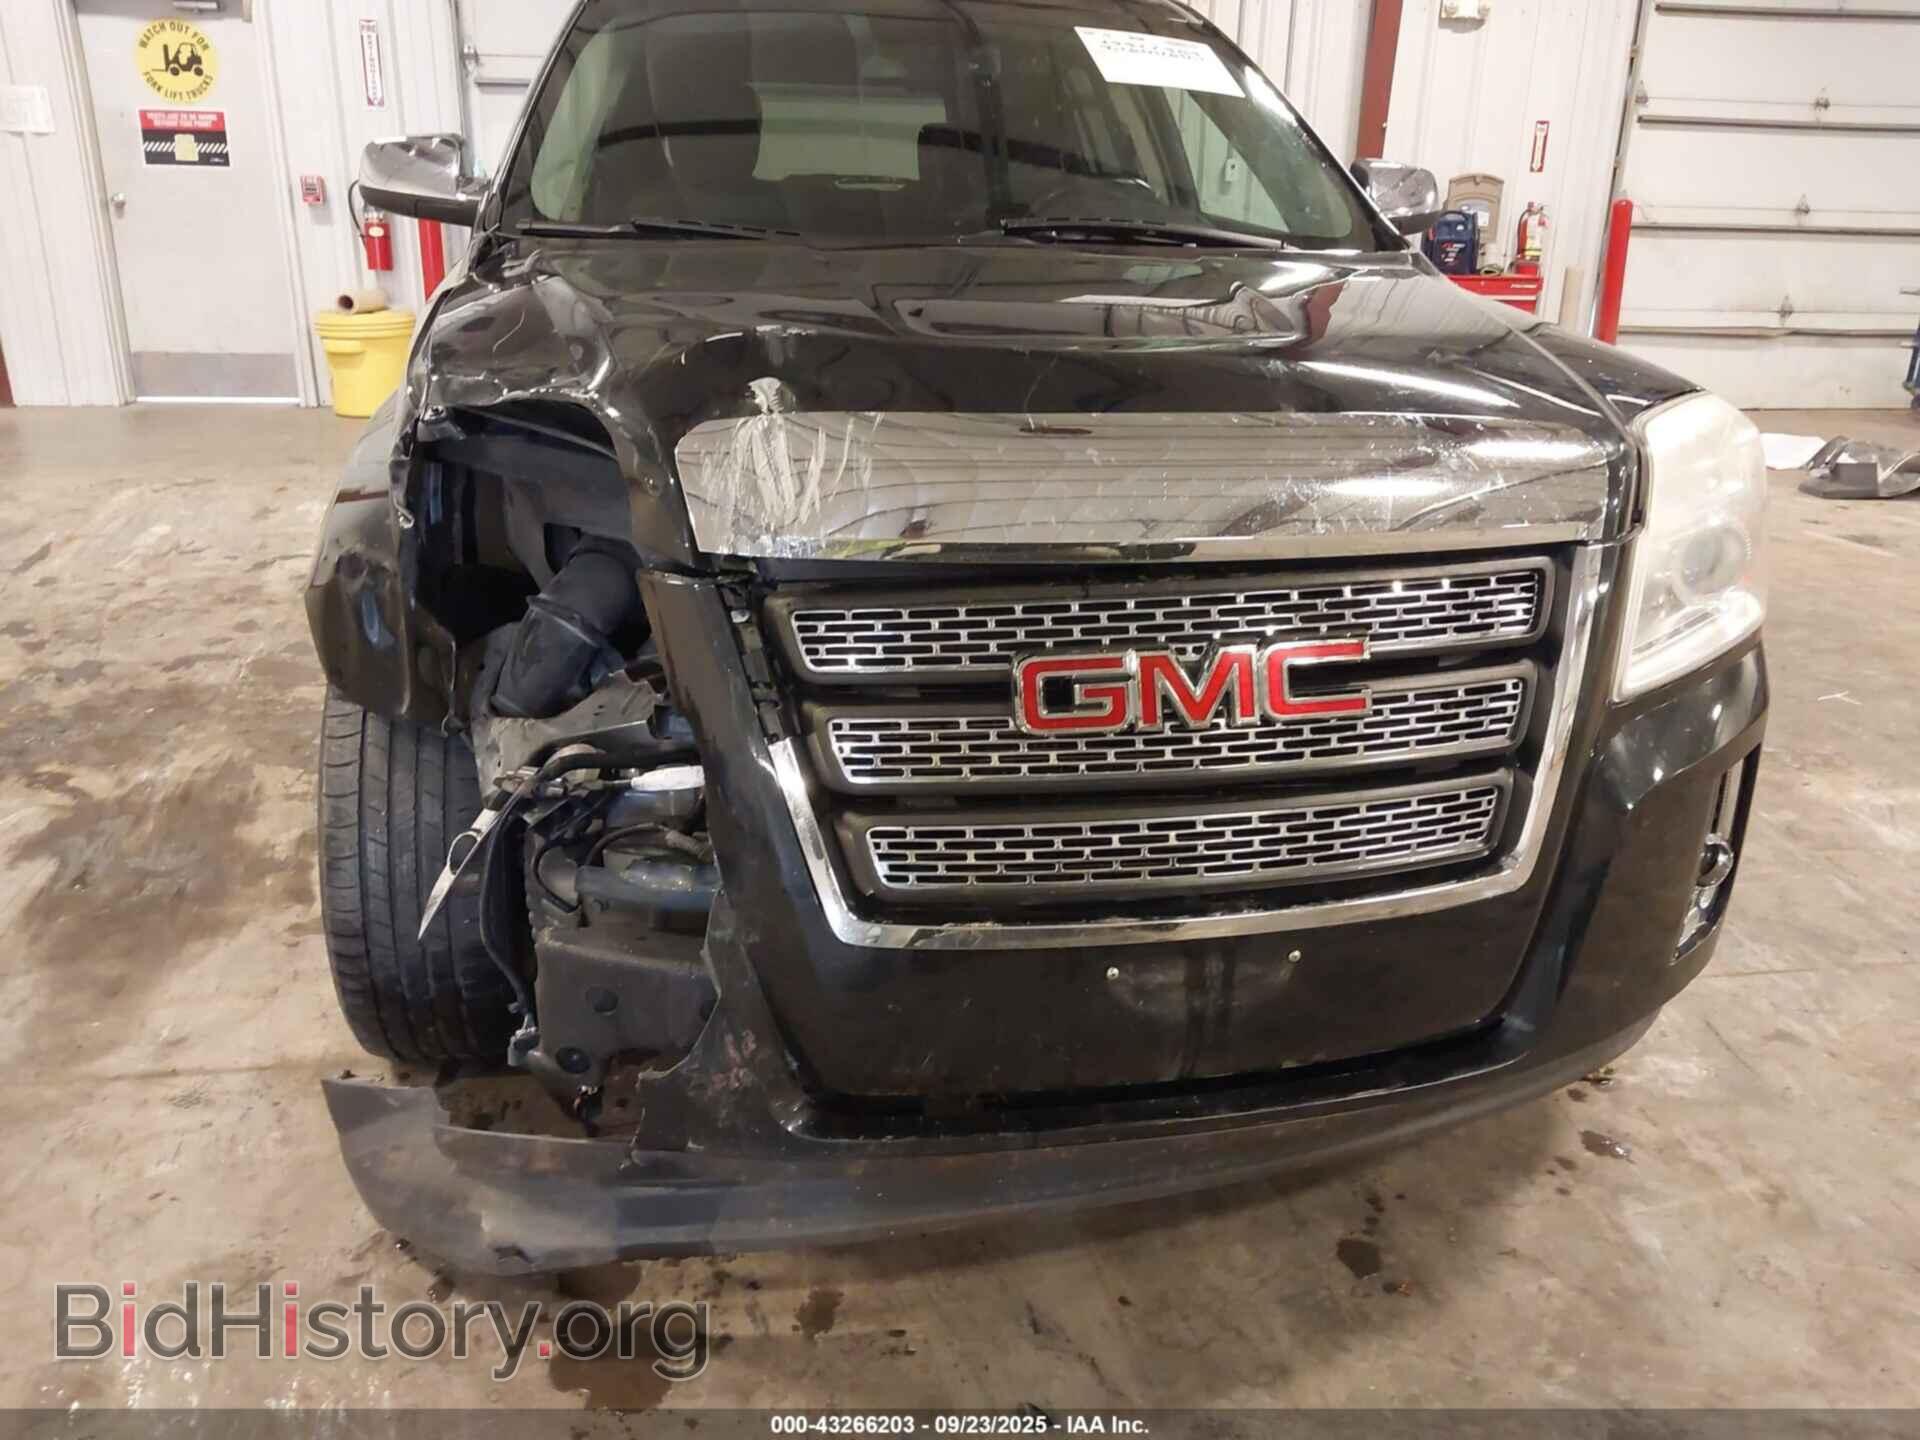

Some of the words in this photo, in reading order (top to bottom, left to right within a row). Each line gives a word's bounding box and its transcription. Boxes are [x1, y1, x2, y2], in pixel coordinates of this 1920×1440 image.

[139, 21, 167, 49] WATCH
[170, 21, 190, 34] OUT
[192, 31, 210, 50] FOR
[143, 71, 163, 92] FORK
[165, 89, 183, 101] LIFT
[186, 74, 213, 99] TRUCKS
[1014, 638, 1371, 736] GMC
